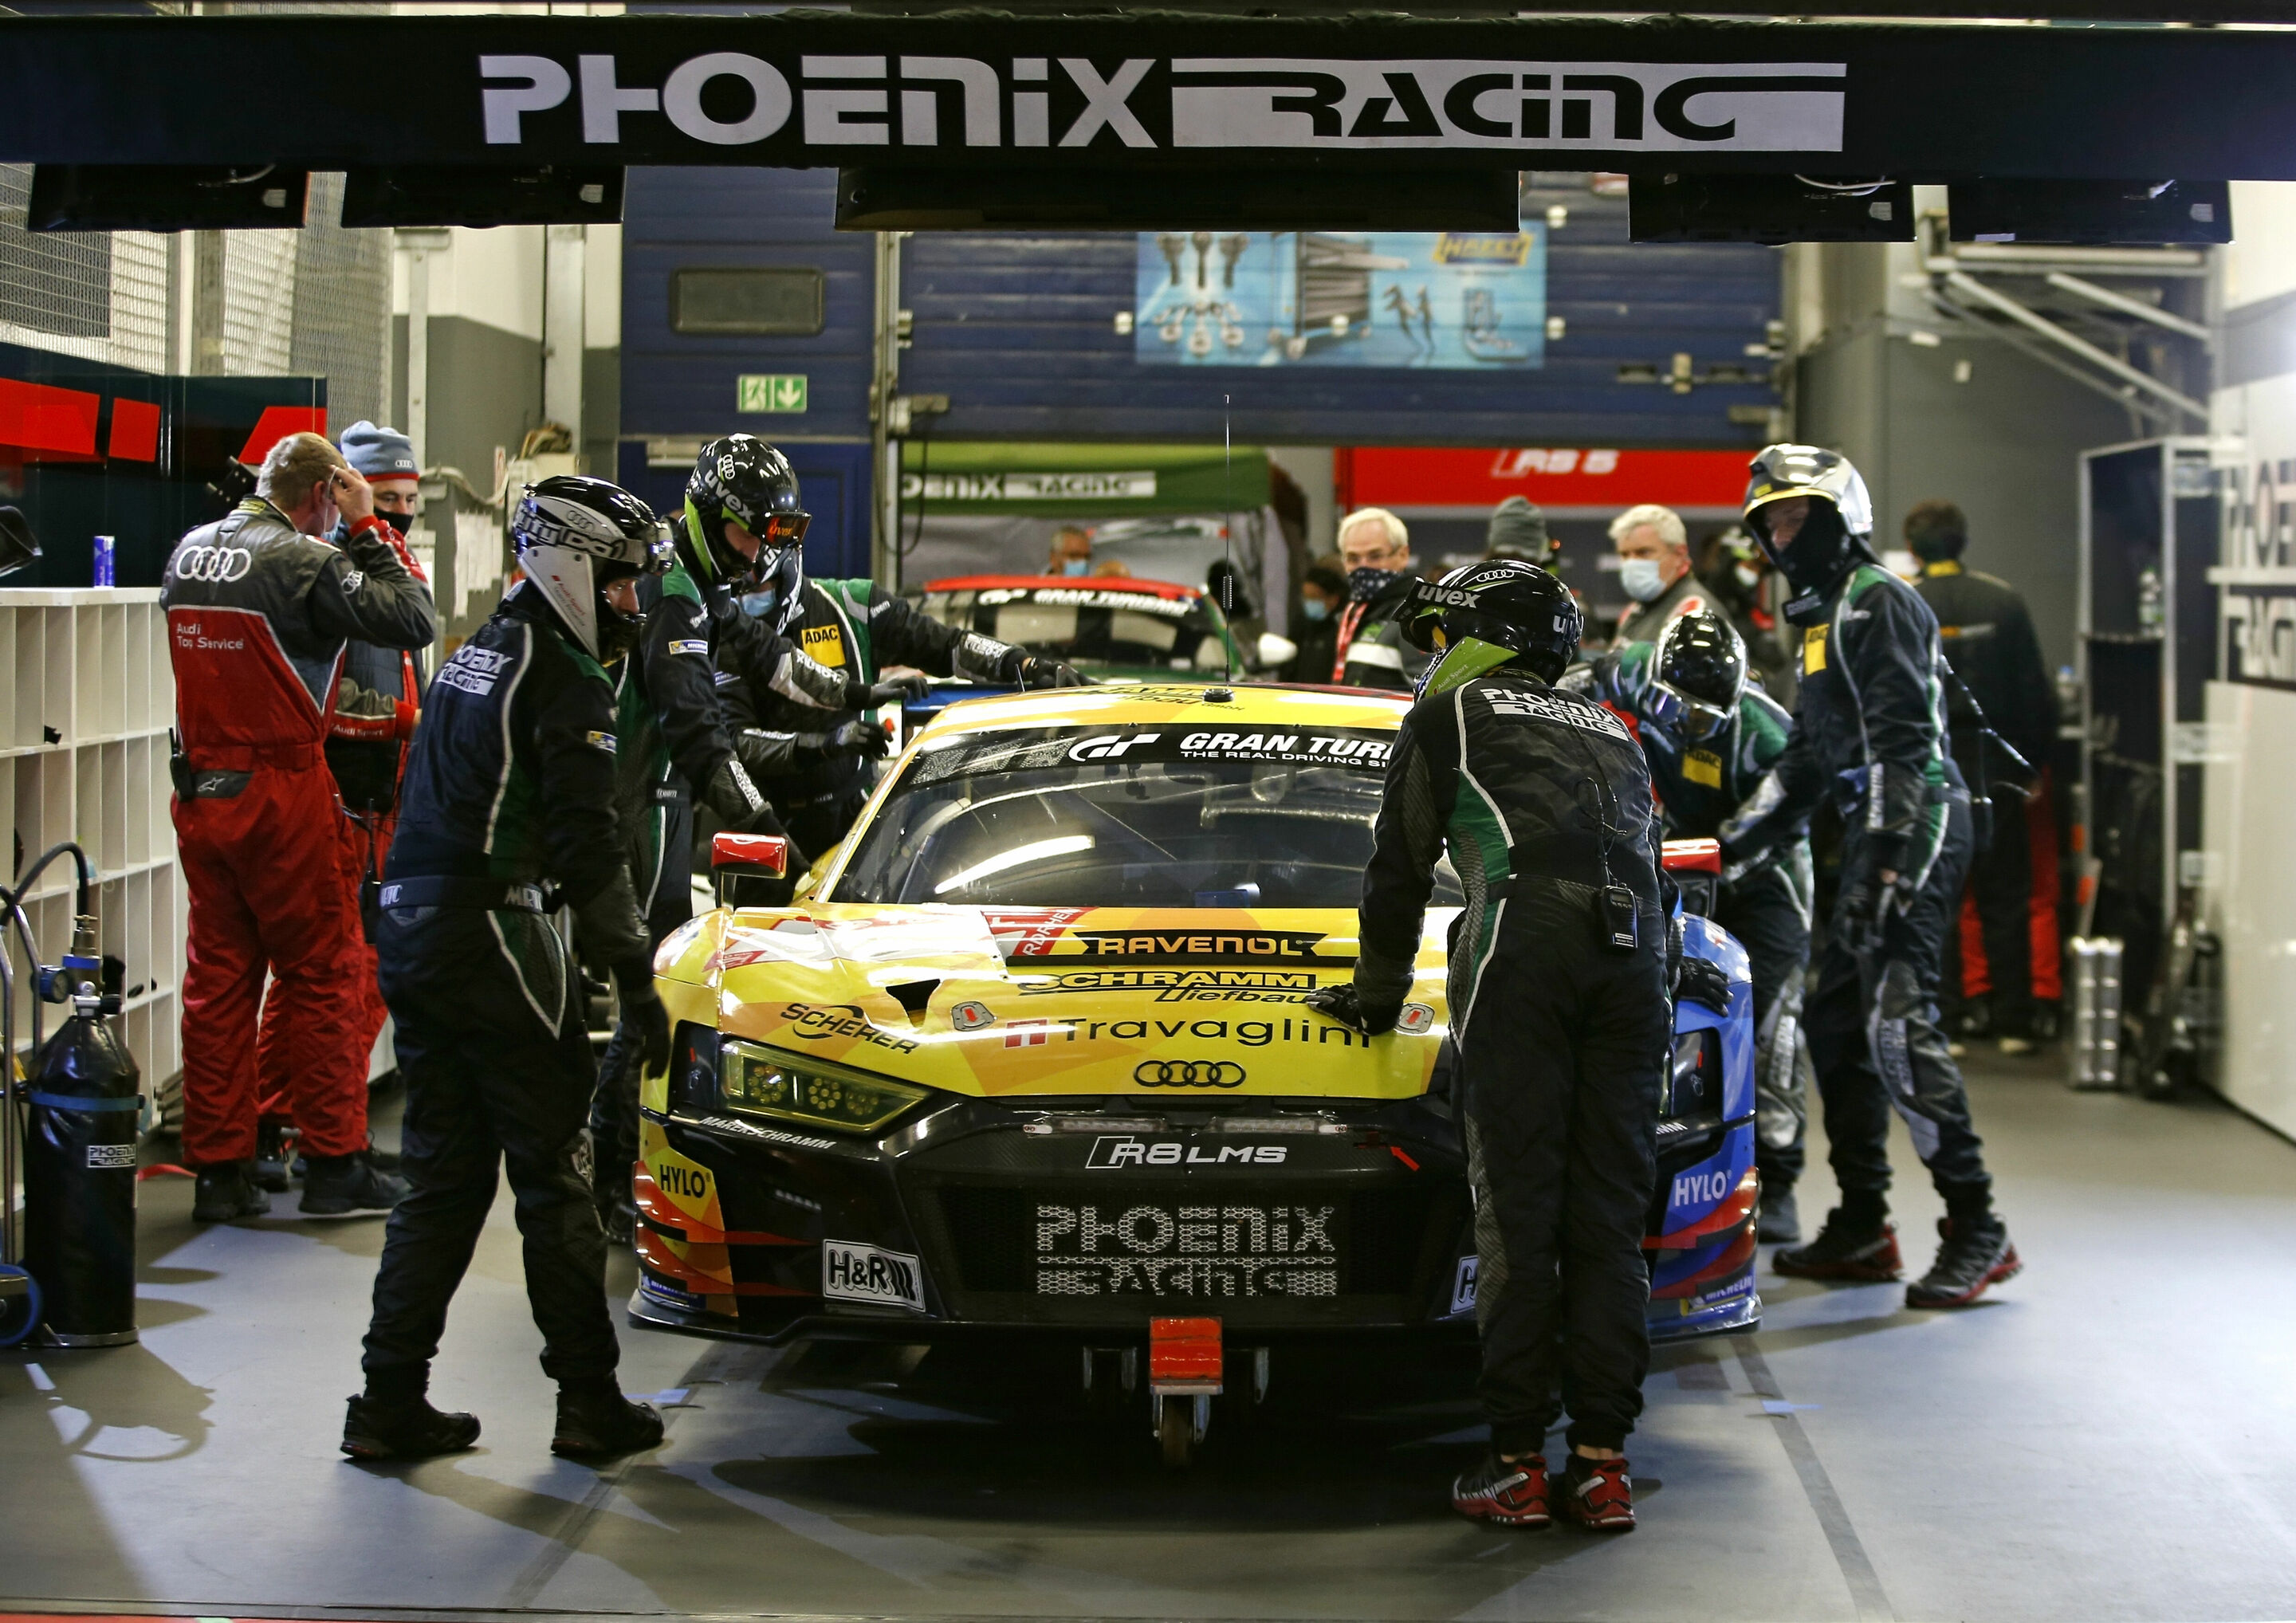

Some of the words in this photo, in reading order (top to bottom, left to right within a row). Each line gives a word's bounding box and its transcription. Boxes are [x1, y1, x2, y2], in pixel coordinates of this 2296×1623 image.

[479, 53, 1158, 148] PHOENIX
[1172, 68, 1846, 143] RACING
[705, 470, 755, 524] uvex
[1417, 584, 1481, 608] uvex
[176, 623, 201, 635] Audi
[805, 627, 839, 644] ADAC
[197, 636, 243, 650] Service
[1179, 732, 1289, 753] GRAN
[1225, 751, 1272, 760] REAL
[1284, 753, 1362, 765] DRIVING
[1097, 936, 1303, 956] RAVENOL
[1021, 971, 1313, 991] SCHRAMM
[780, 1002, 921, 1055] SCHERER
[1108, 1142, 1183, 1165] R8
[1186, 1146, 1288, 1163] LMS
[660, 1163, 705, 1198] HYLO
[1675, 1170, 1727, 1207] HYLO
[1037, 1204, 1336, 1253] PHOENIX
[829, 1249, 893, 1295] H&R
